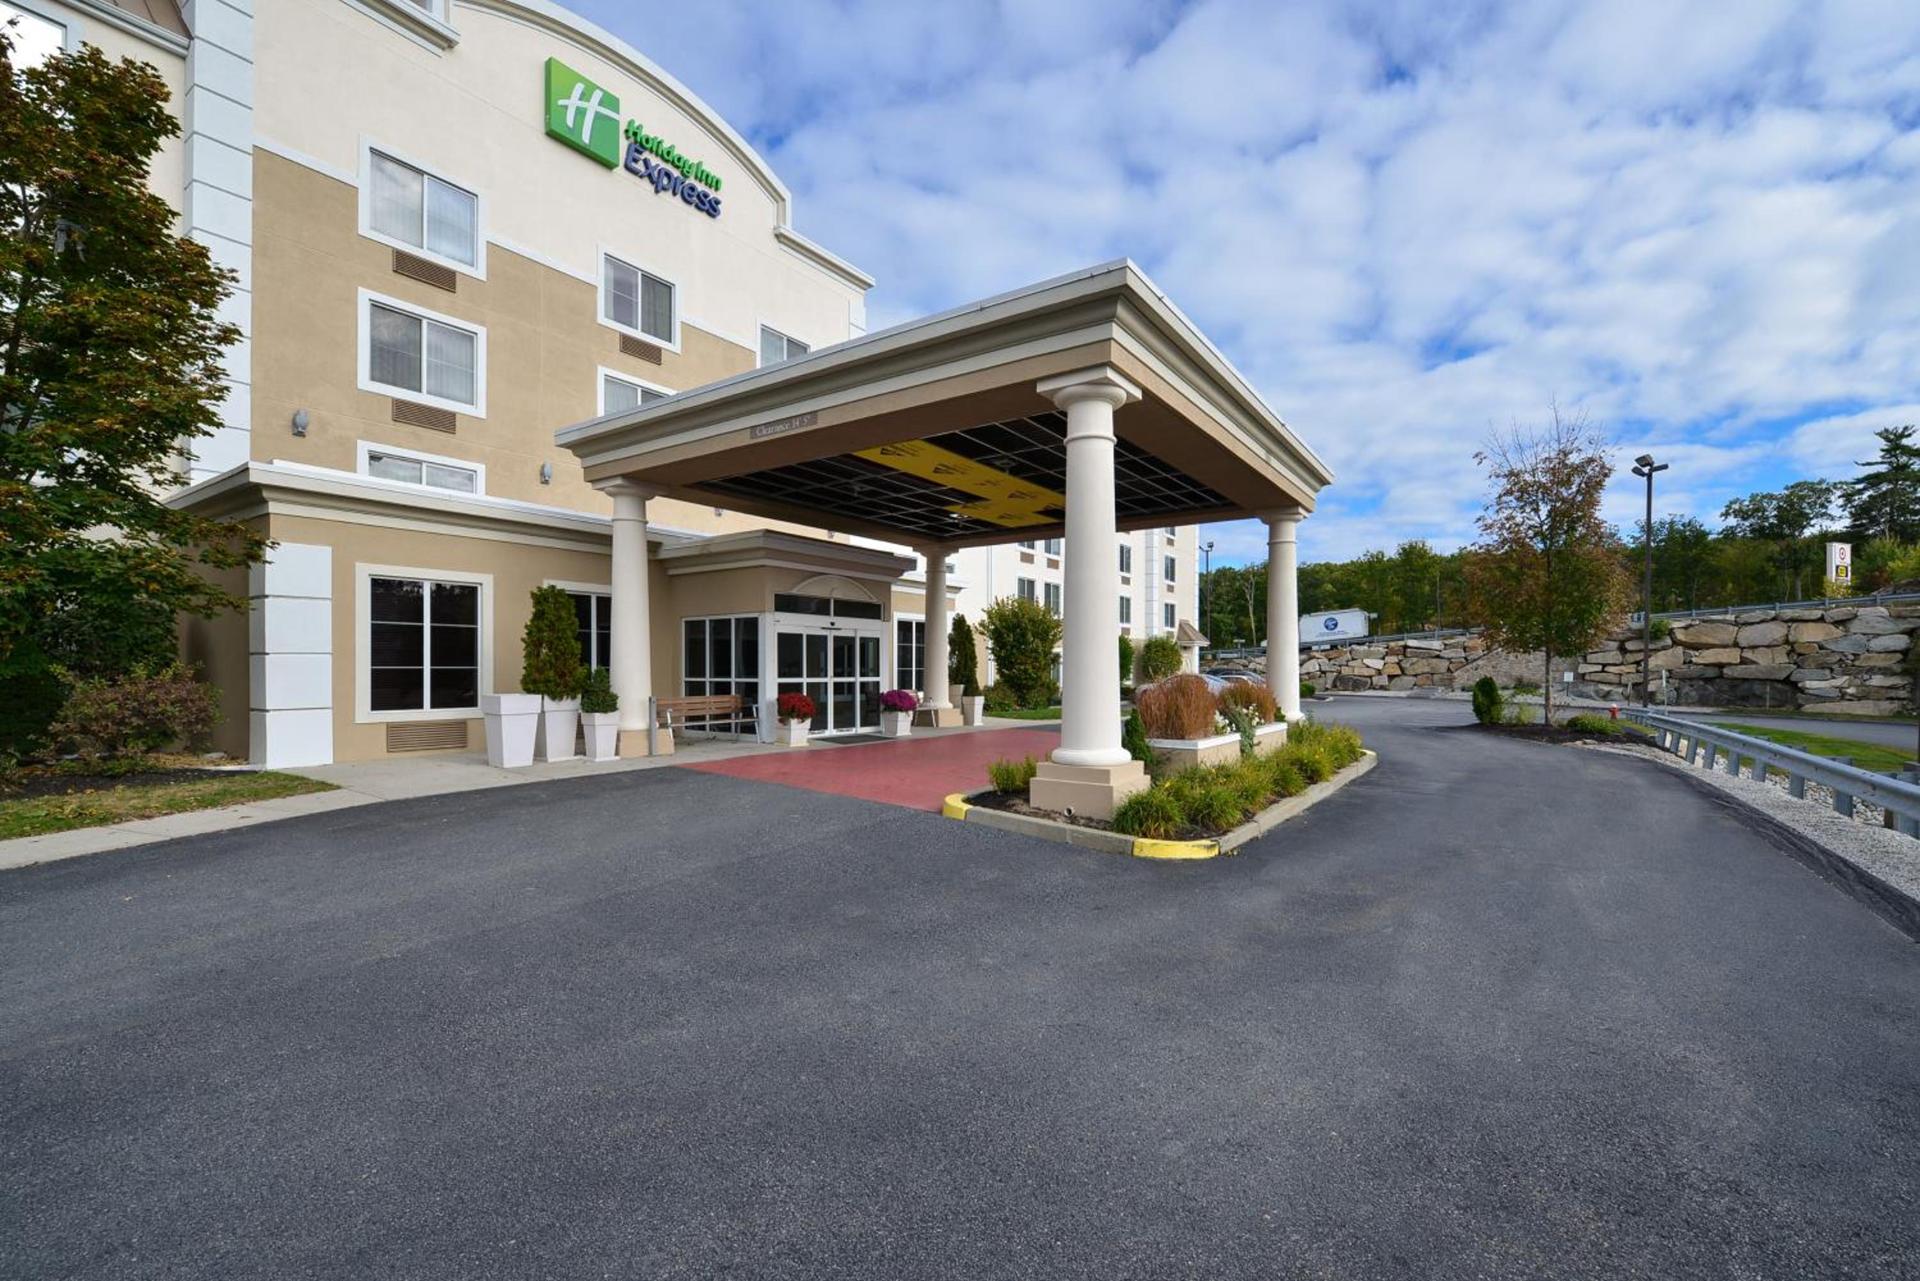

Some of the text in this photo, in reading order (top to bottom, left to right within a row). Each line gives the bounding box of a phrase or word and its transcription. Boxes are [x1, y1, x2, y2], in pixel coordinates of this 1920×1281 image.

[624, 119, 721, 191] Holiday Inn
[624, 142, 721, 218] Express
